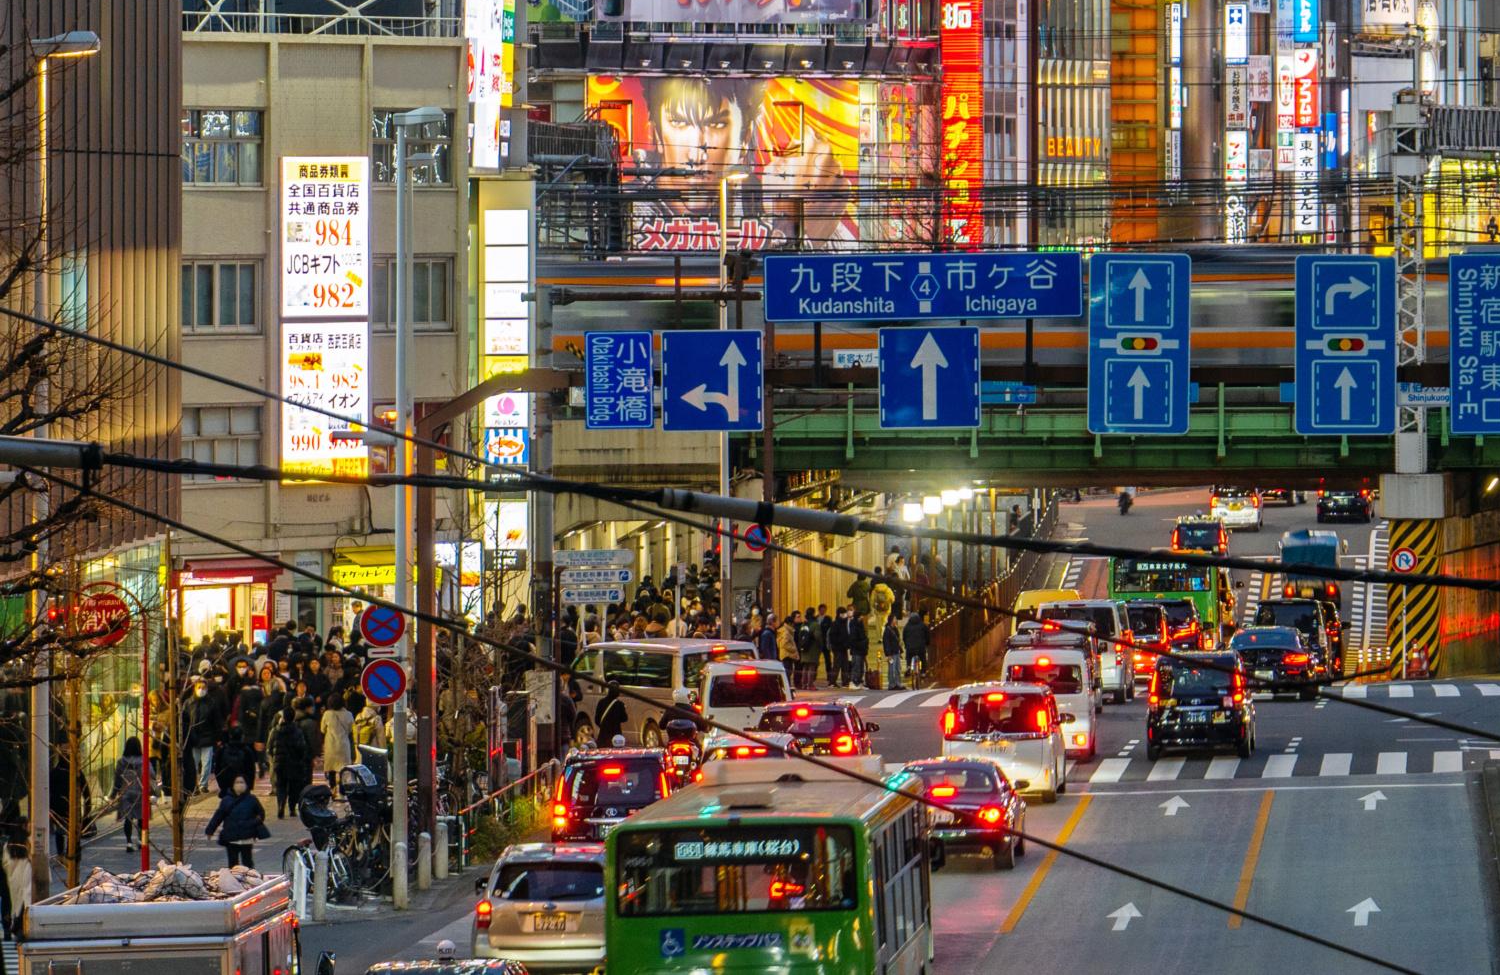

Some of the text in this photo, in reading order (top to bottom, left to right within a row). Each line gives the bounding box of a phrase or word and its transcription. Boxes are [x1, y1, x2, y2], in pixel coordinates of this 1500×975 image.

[1299, 79, 1312, 106] アコム
[1047, 137, 1101, 158] BEAUTY
[288, 183, 360, 199] 全国百貨店
[288, 201, 360, 216] 共通商品券
[315, 219, 353, 247] 984
[286, 253, 341, 276] JCBギフト
[789, 261, 905, 294] 九段下
[917, 277, 932, 296] 4
[313, 282, 355, 308] 982
[799, 294, 1038, 315] Kudanshita Ichigaya
[1456, 268, 1479, 349] Shinjuku
[288, 333, 324, 344] 百貨店
[590, 336, 611, 425] Otakibashi Brdg.
[615, 338, 648, 423] 小滝橋
[328, 393, 361, 409] イオン
[290, 434, 321, 452] 990
[692, 931, 784, 949] ノンステップバス
